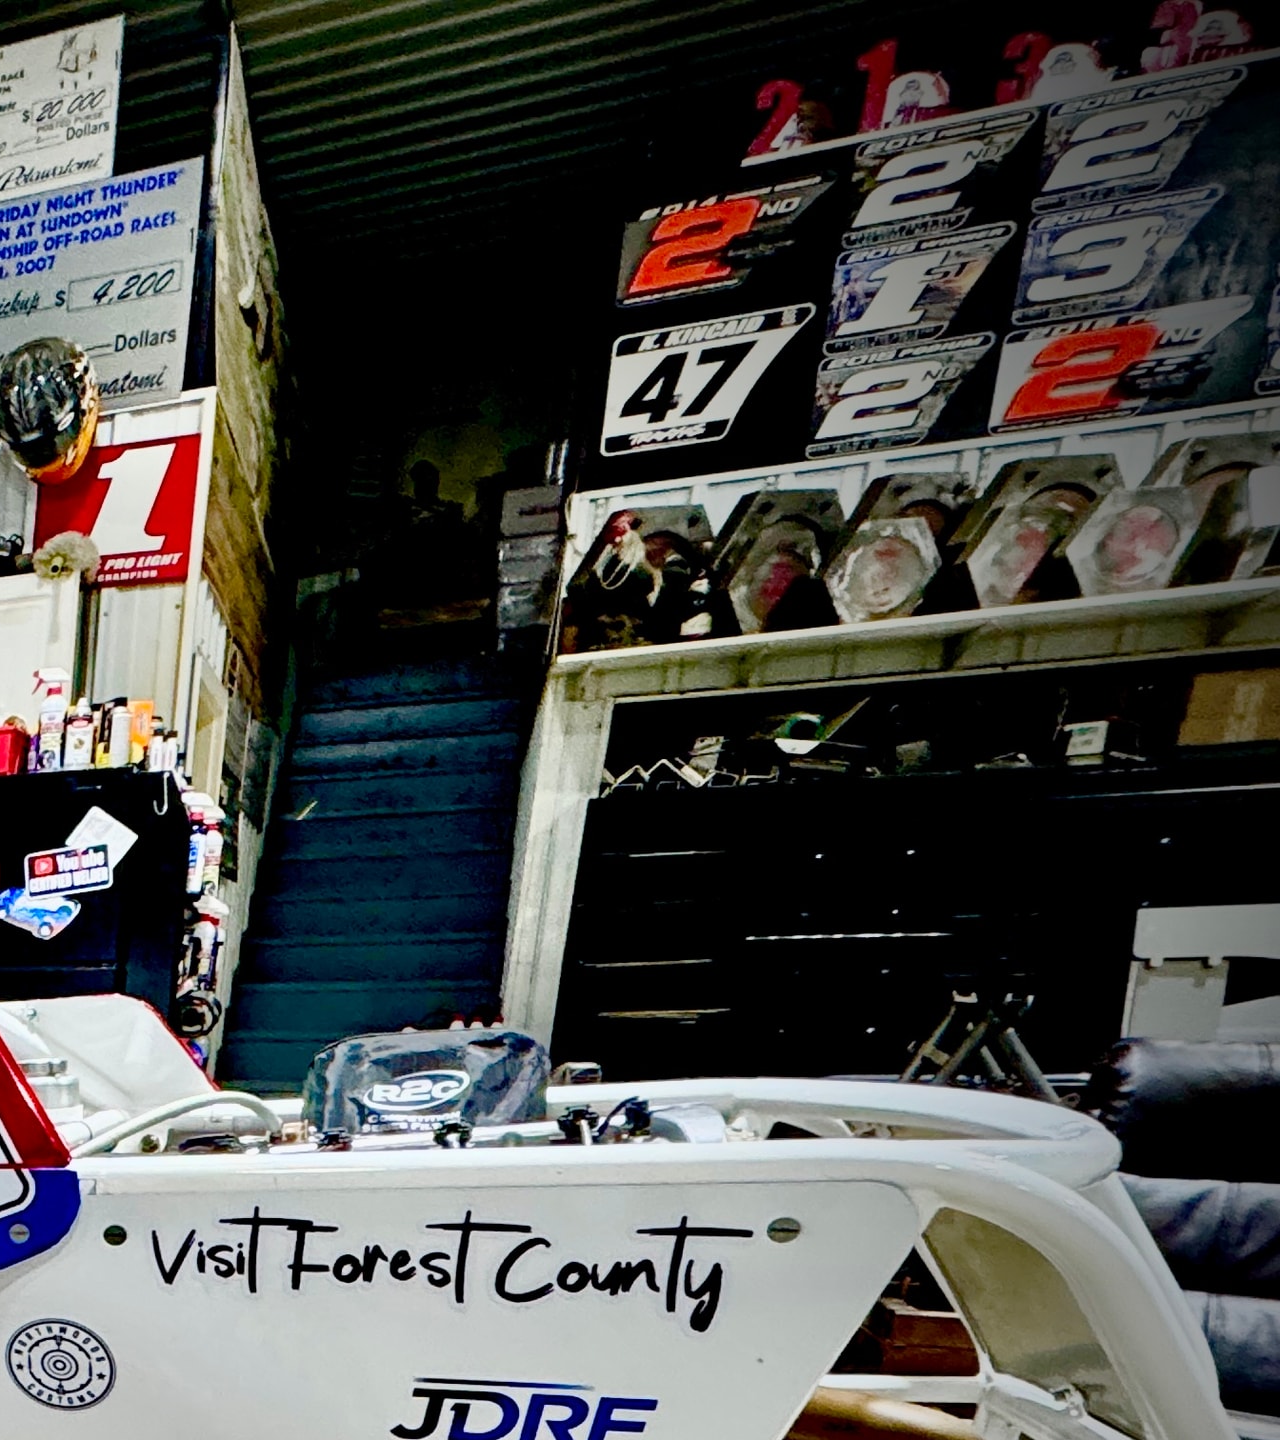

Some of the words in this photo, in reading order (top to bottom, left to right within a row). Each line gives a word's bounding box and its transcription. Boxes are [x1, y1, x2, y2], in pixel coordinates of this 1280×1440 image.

[1, 69, 25, 83] RACE
[22, 110, 31, 123] $
[66, 121, 110, 142] Dollars
[1041, 98, 1184, 193] 2
[47, 190, 96, 213] NIGHT
[851, 140, 982, 229] 2
[16, 222, 35, 239] AT
[43, 222, 125, 252] OFF-ROAD
[130, 211, 176, 234] RACES
[16, 255, 56, 276] 2007
[626, 197, 763, 300] 2
[758, 197, 802, 218] ND
[1027, 214, 1166, 303] 3
[114, 328, 177, 352] Dollars
[663, 315, 766, 349] KINCAID
[619, 339, 761, 424] 47
[1003, 323, 1157, 424] 2
[814, 360, 942, 440] 2
[90, 442, 177, 557] 1
[104, 555, 136, 571] PRO
[136, 552, 183, 568] LIGHT
[371, 1078, 461, 1103] R2C
